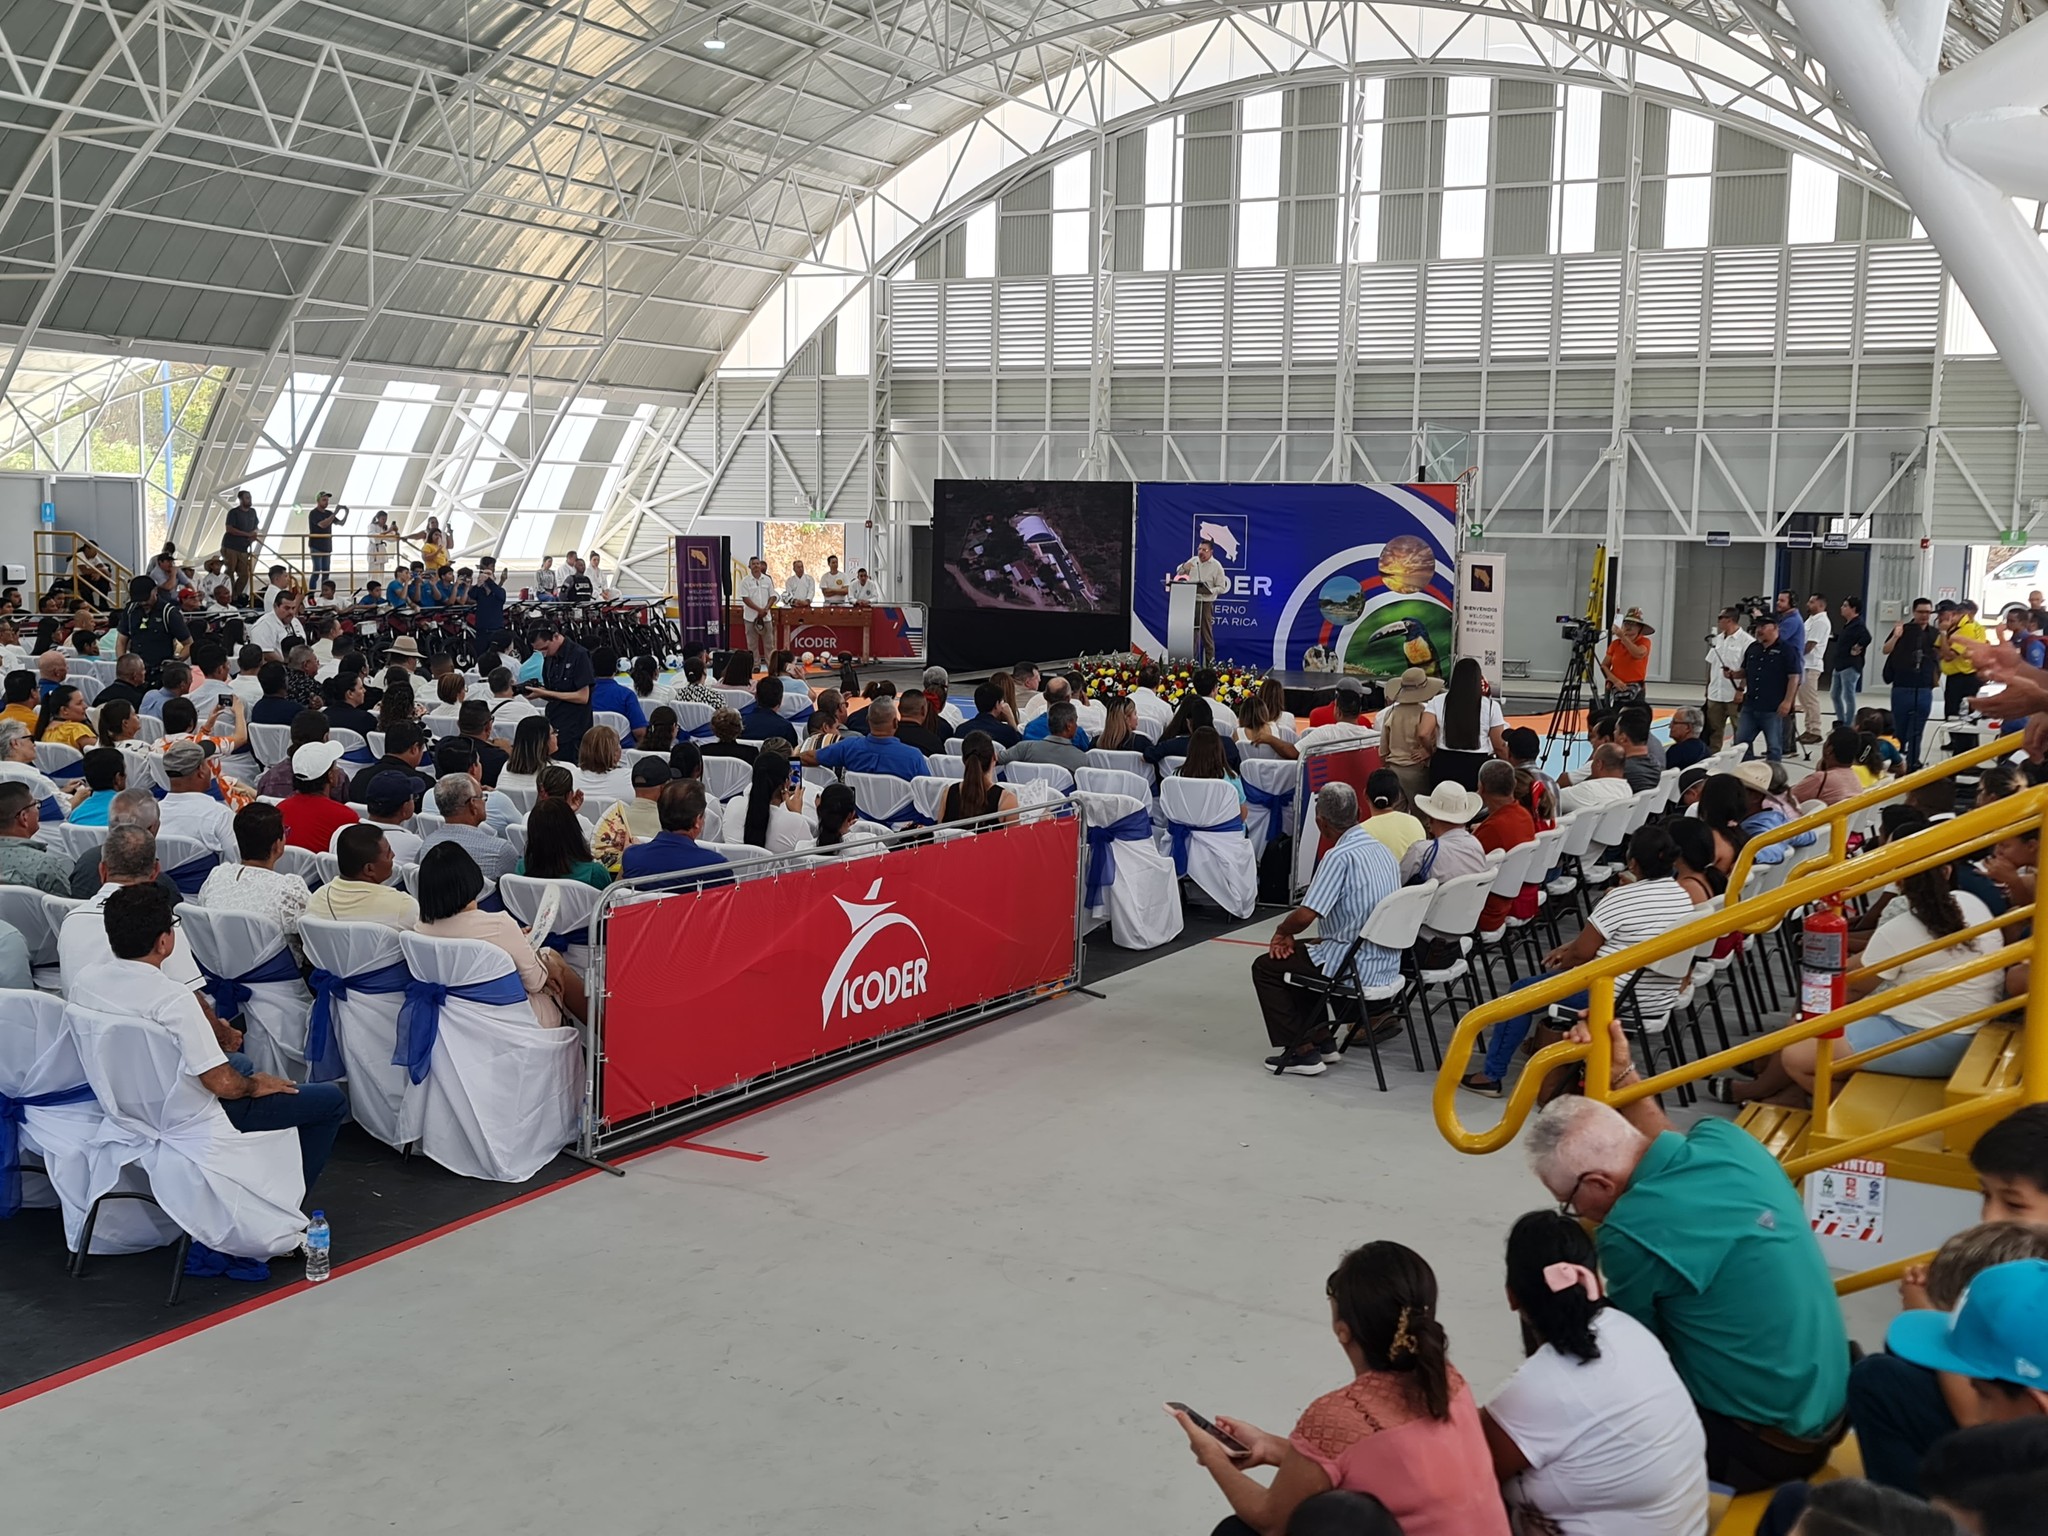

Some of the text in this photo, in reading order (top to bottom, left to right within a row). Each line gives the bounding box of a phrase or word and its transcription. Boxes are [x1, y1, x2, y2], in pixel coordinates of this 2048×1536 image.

[1463, 605, 1498, 613] BIENVENIDOS
[1231, 617, 1258, 627] RICA
[1466, 627, 1495, 635] BIENVENUE
[794, 636, 837, 649] ICODER
[841, 957, 928, 1019] ICODER
